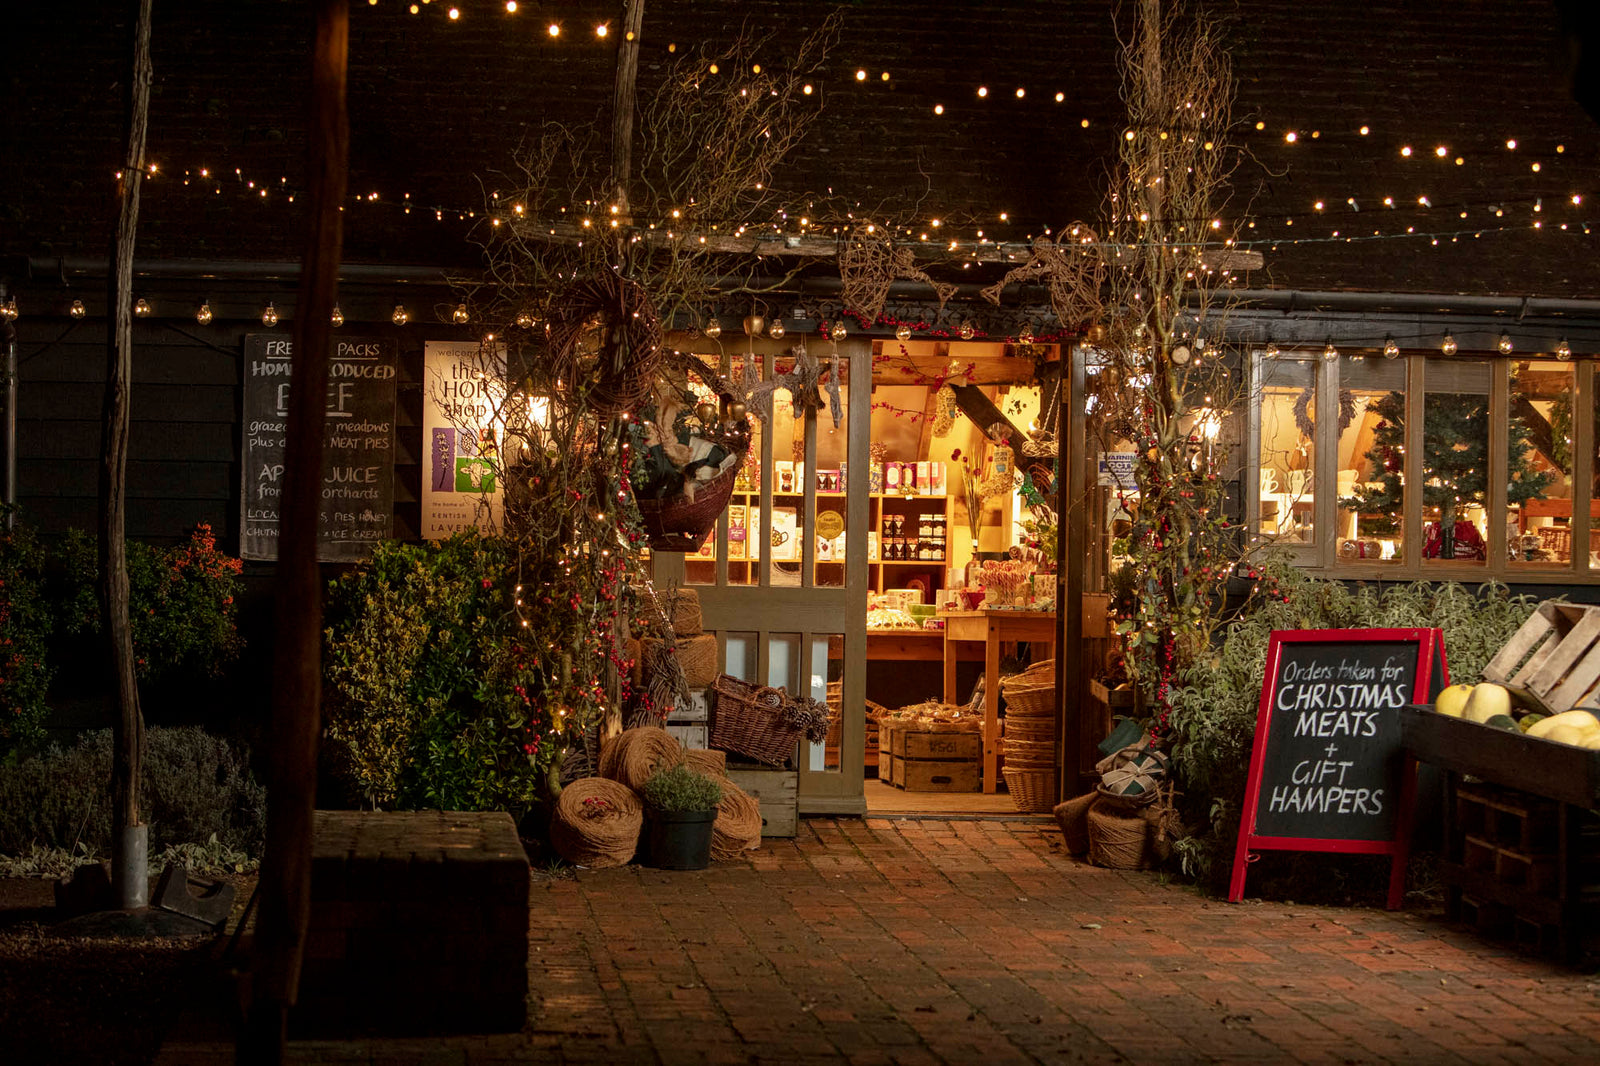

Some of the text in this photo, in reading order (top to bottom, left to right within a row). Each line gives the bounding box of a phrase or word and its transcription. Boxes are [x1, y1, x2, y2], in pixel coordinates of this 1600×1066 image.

[337, 342, 380, 356] PACKS
[252, 361, 396, 379] HOM ODUCED
[452, 361, 480, 379] the
[444, 399, 486, 422] shop
[336, 418, 390, 432] meadows
[249, 436, 274, 454] plus
[330, 438, 361, 449] MEAT
[365, 437, 390, 449] PIES
[324, 466, 381, 483] JUICE
[247, 509, 281, 520] LOCA
[246, 528, 281, 538] CHUTN
[331, 529, 348, 538] ICE
[1283, 656, 1404, 682] Orders taken for
[1277, 683, 1407, 711] CHRISTMAS
[1294, 711, 1380, 737] MEATS
[1324, 743, 1338, 757] +
[1291, 760, 1354, 785] GIFT
[1269, 786, 1384, 815] HAMPERS
